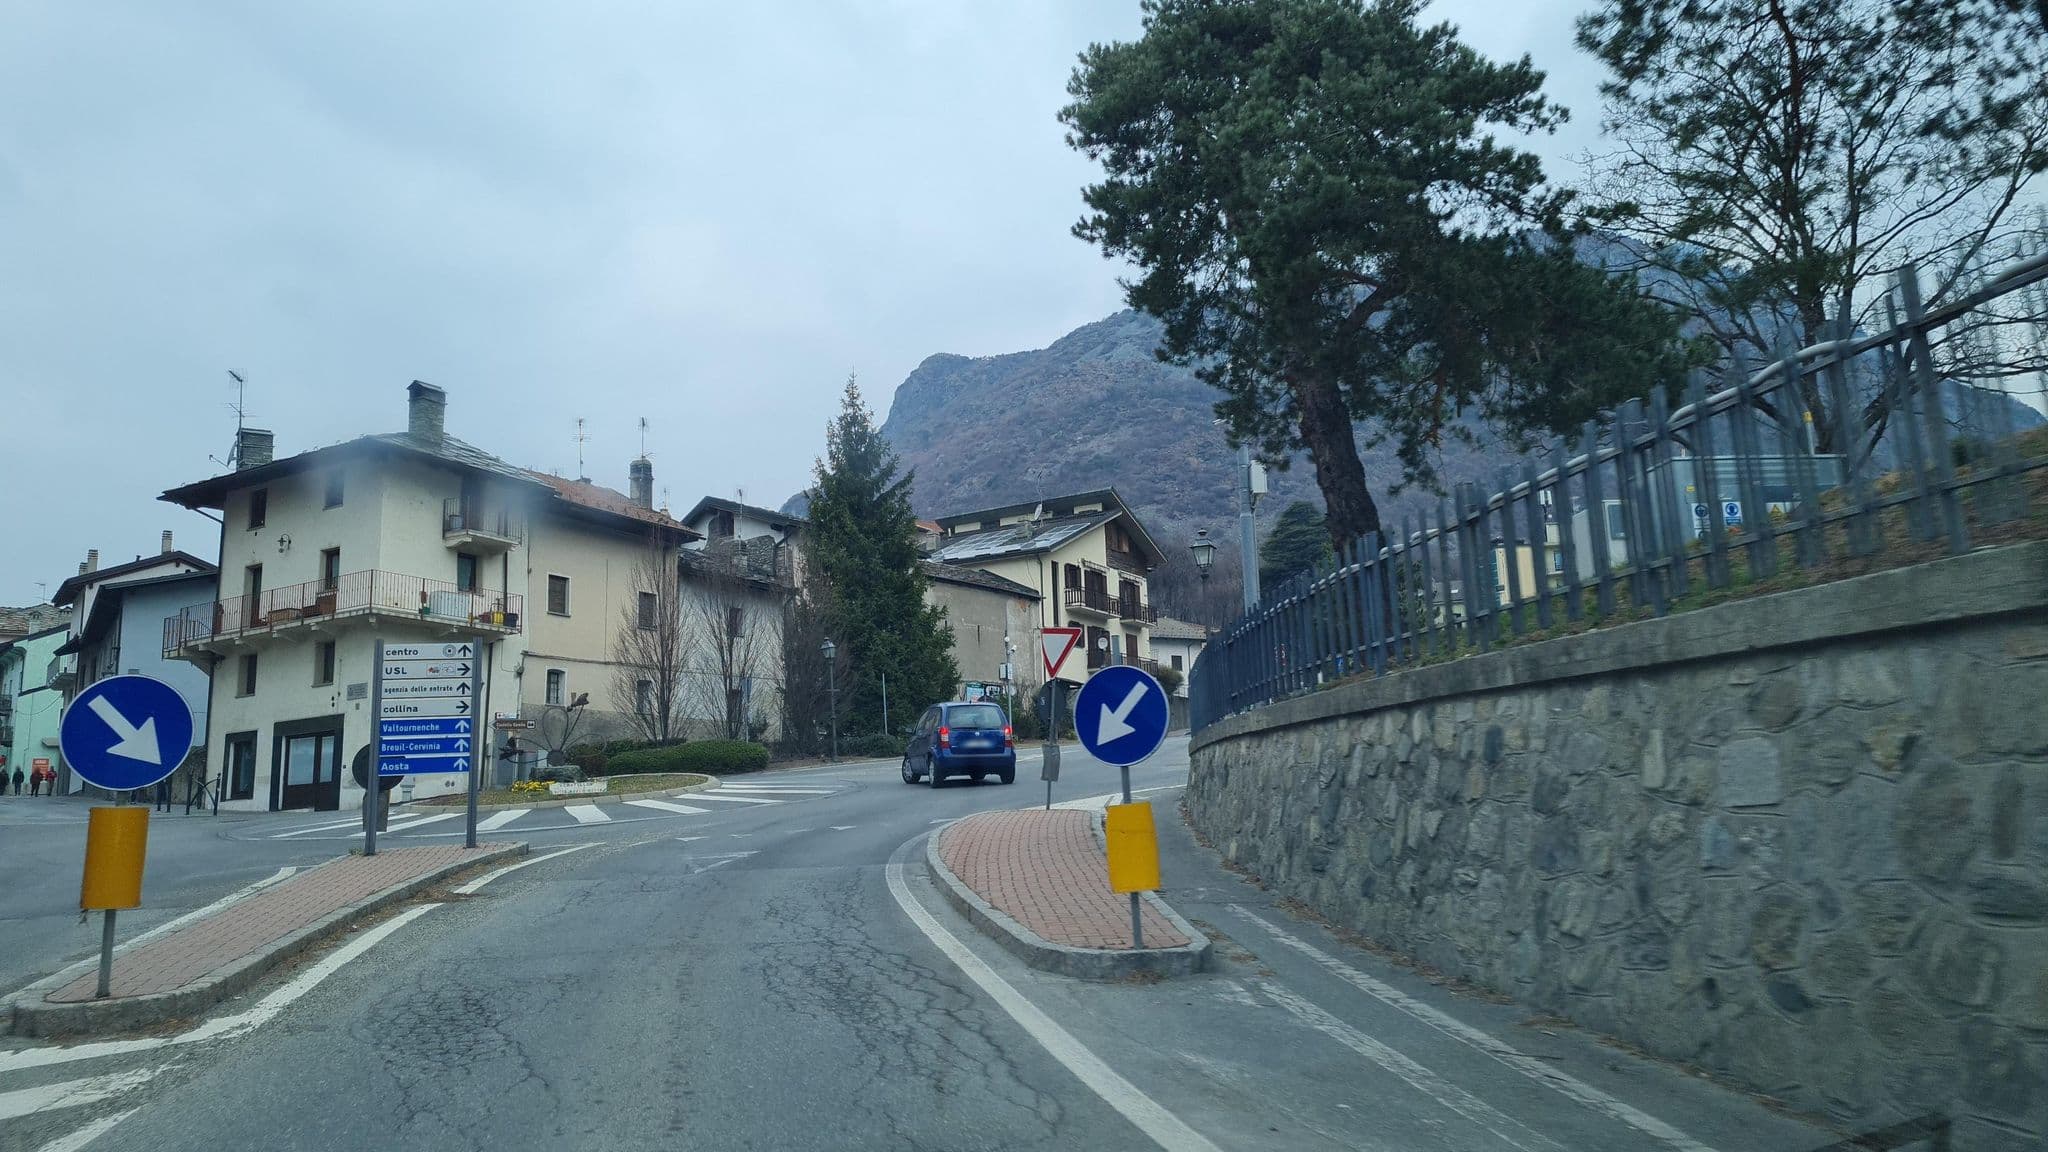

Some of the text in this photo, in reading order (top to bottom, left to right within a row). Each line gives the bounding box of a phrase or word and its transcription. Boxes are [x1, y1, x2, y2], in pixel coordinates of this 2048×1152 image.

[385, 648, 418, 656] centro
[384, 704, 418, 712] collina
[382, 724, 440, 732] Valtournenche
[382, 742, 440, 752] Breuil-Cervinia
[381, 762, 409, 771] Aosta
